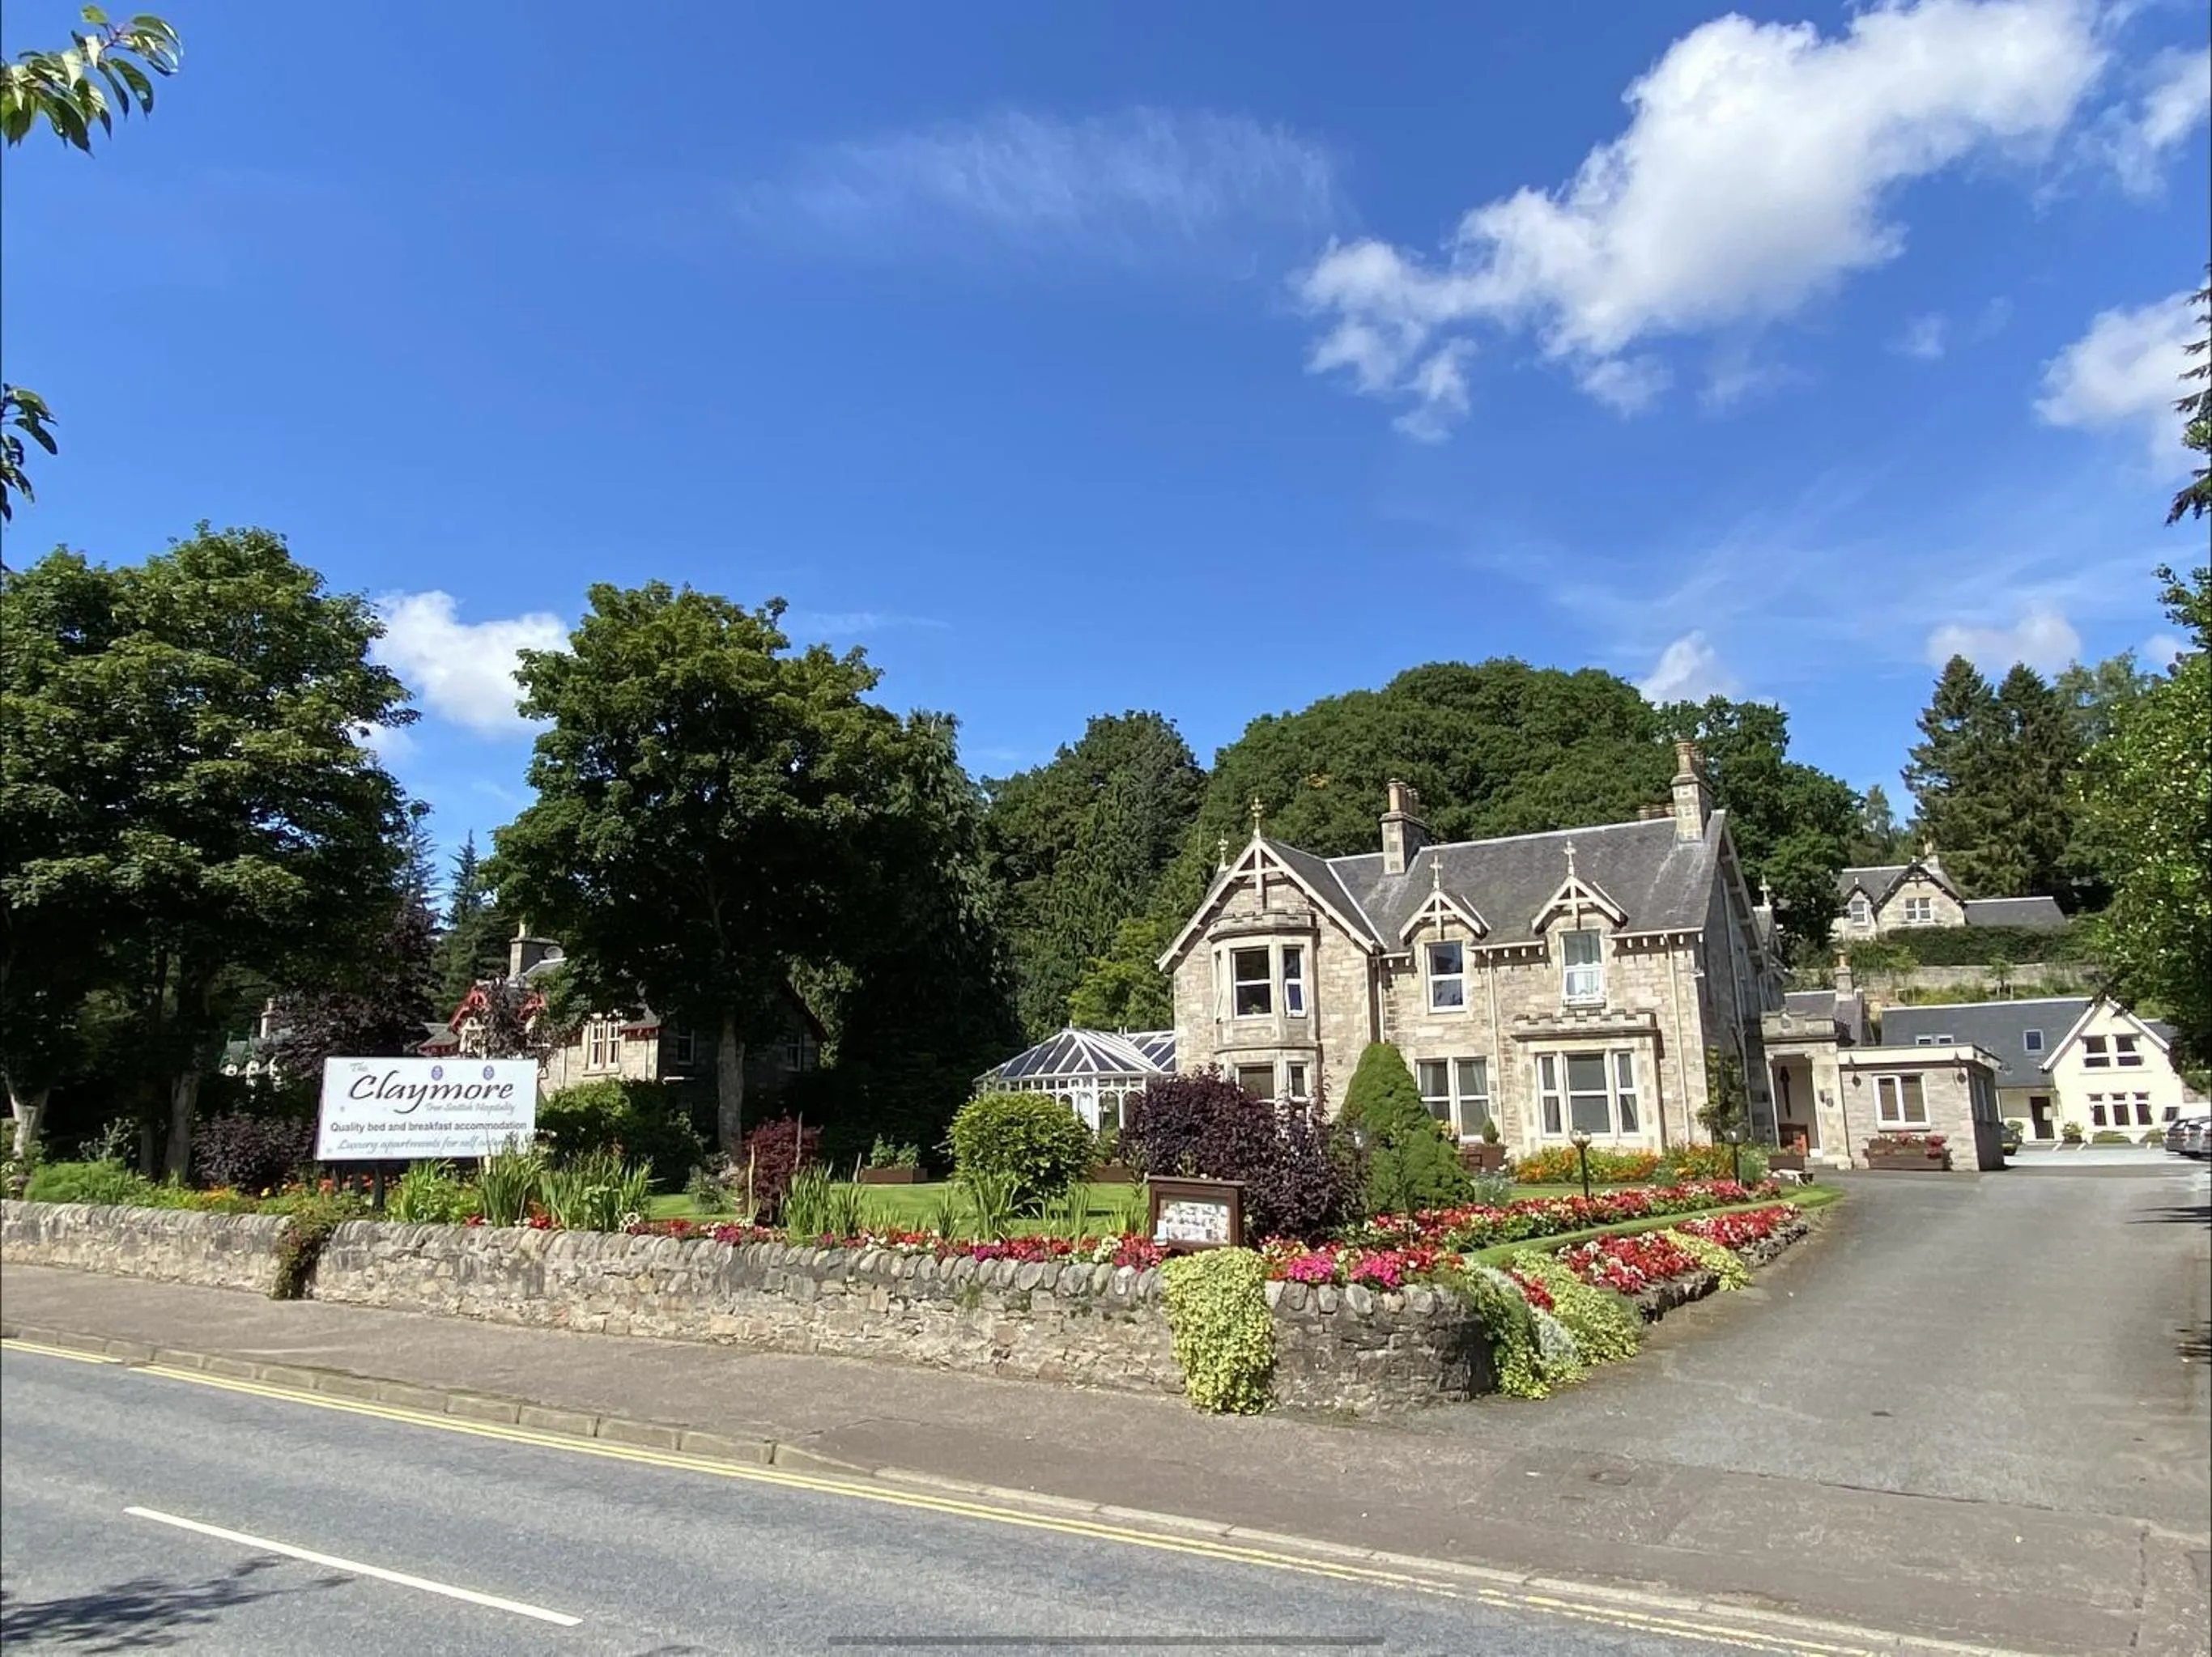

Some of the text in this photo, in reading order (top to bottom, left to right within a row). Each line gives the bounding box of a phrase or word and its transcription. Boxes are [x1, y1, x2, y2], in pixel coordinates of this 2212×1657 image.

[349, 1069, 514, 1114] Claymore
[330, 1121, 527, 1133] Quality bed and breakfast accommodation
[338, 1139, 377, 1154] Luxury
[381, 1137, 439, 1154] apartments
[439, 1136, 458, 1154] for
[459, 1135, 479, 1152] self
